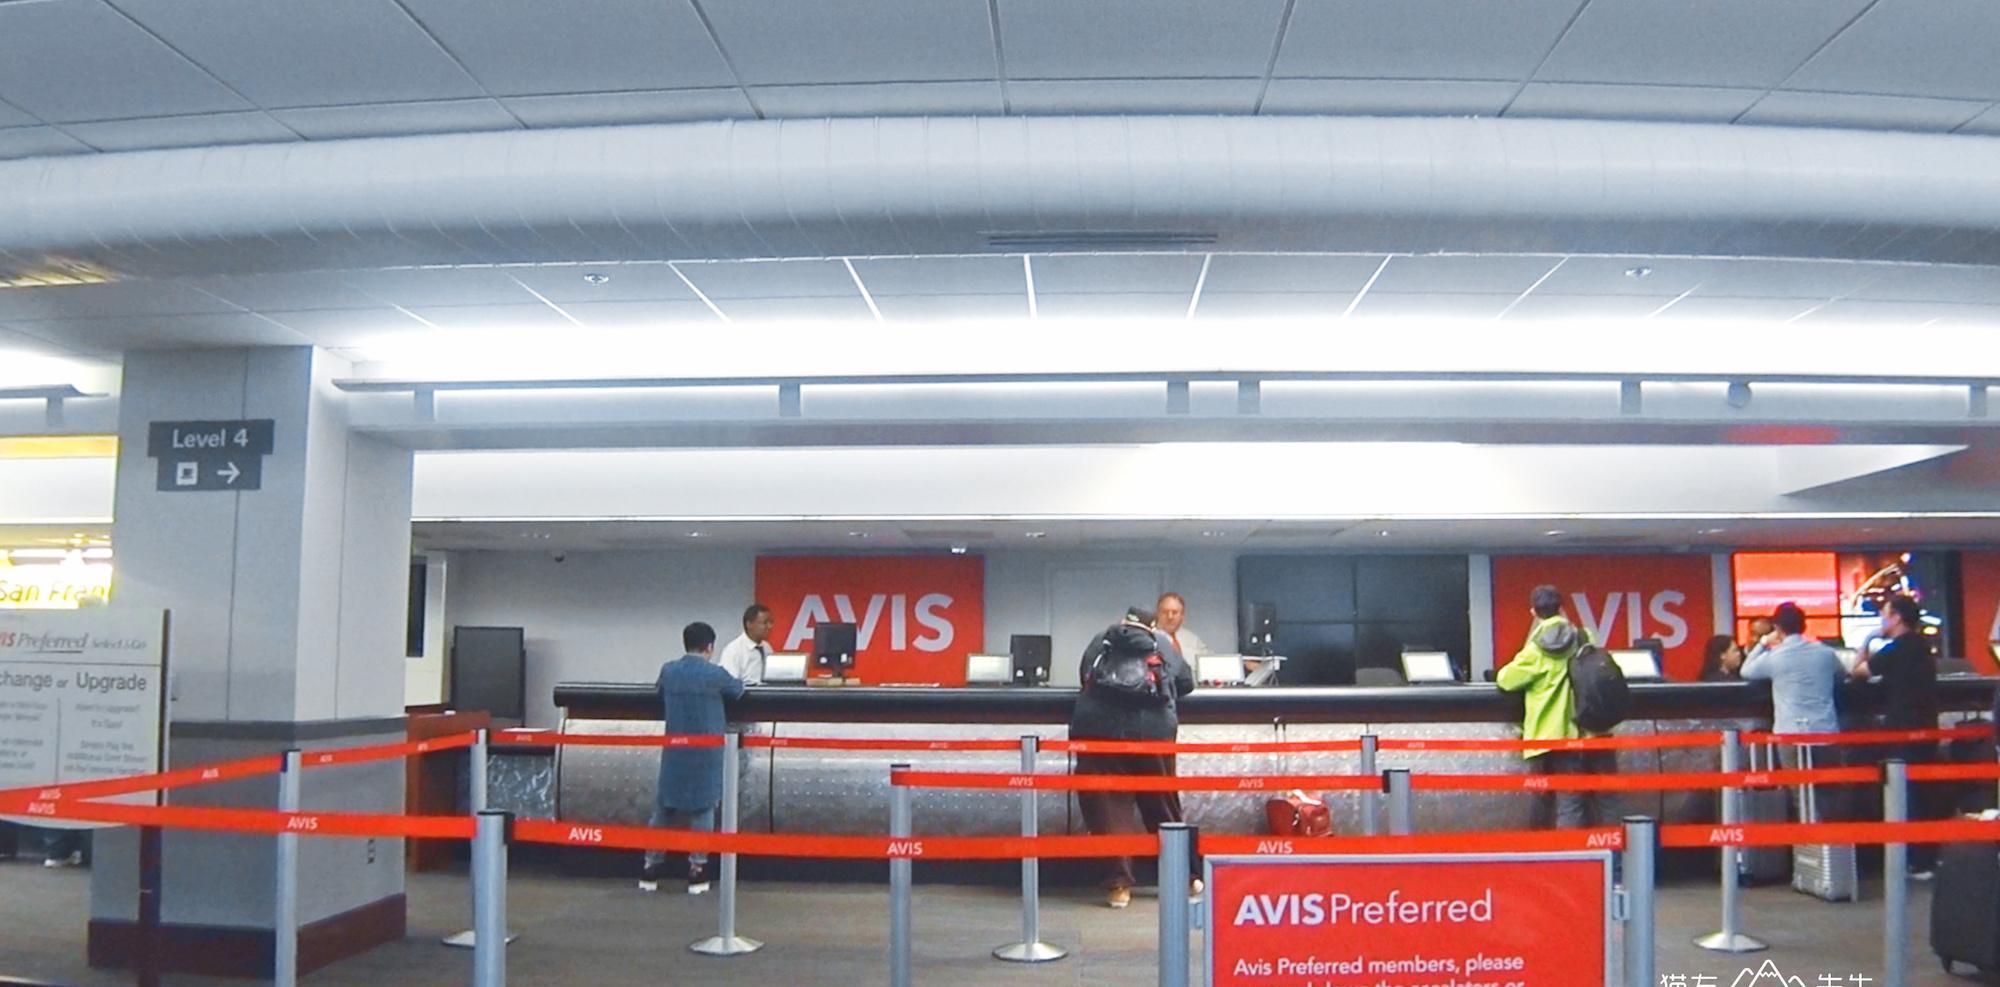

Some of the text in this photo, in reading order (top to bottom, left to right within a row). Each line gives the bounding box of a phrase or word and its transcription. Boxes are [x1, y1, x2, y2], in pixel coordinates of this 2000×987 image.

[172, 428, 249, 449] Level 4
[783, 593, 955, 651] AVIS
[17, 632, 89, 651] Preferred
[56, 679, 69, 689] or
[76, 672, 147, 693] Upgrade
[1008, 776, 1035, 787] AVIS
[1238, 778, 1264, 789] AVIS
[1523, 778, 1548, 789] AVIS
[287, 816, 318, 831] AVIS
[568, 827, 603, 843] AVIS
[1586, 832, 1622, 848] AVIS
[1709, 828, 1744, 843] AVIS
[886, 842, 923, 856] AVIS
[1256, 841, 1294, 855] AVIS
[1233, 888, 1492, 926] AVIS Preferred
[1233, 952, 1524, 977] Avis Preferred members, please
